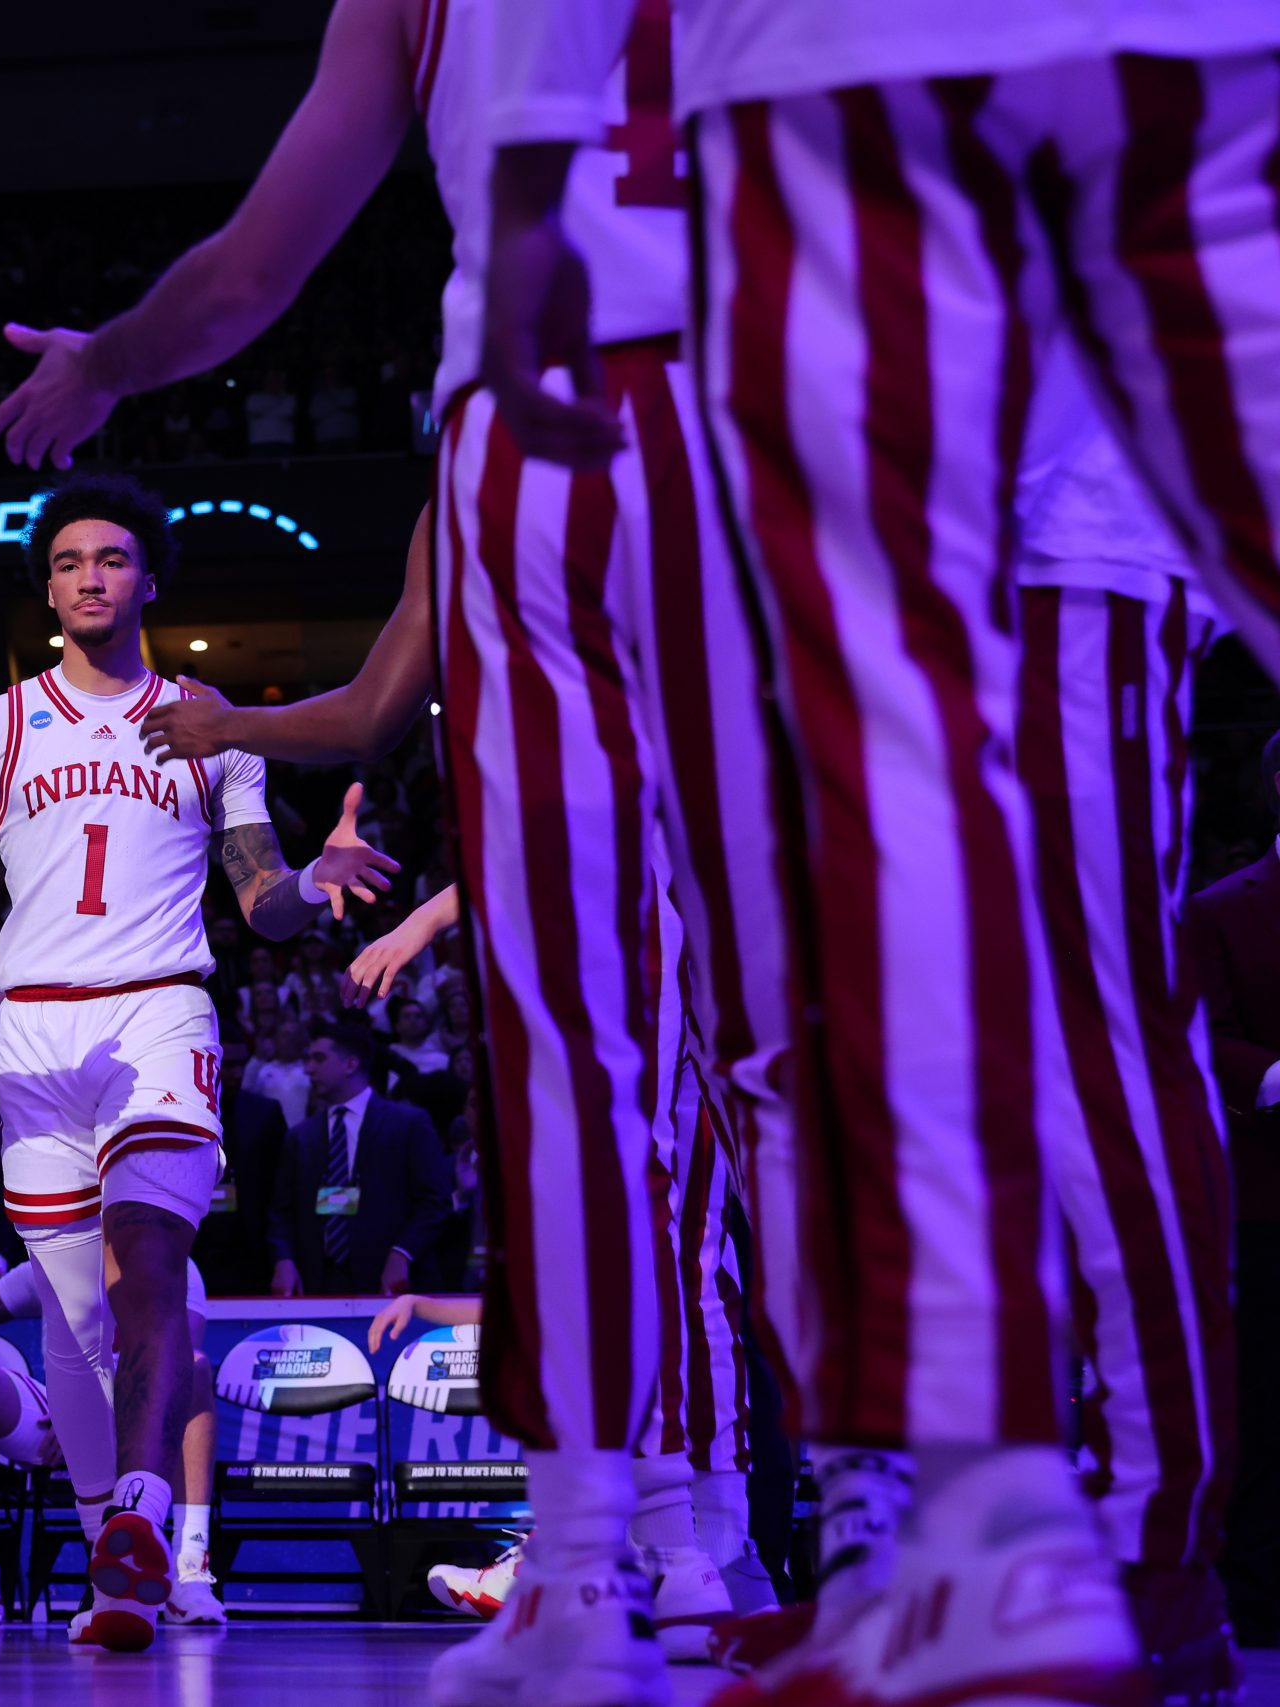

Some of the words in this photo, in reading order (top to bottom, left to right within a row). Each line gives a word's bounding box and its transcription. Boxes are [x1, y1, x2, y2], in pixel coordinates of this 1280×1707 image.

[32, 717, 51, 726] NCAA
[23, 761, 180, 821] INDIANA
[76, 823, 108, 916] 1
[270, 1351, 311, 1363] MARCH
[275, 1362, 330, 1375] MADNESS
[262, 1466, 277, 1477] THE
[278, 1466, 304, 1478] MEN'S
[305, 1467, 327, 1478] FINAL
[328, 1467, 351, 1478] FOUR
[411, 1466, 434, 1477] ROAD
[435, 1466, 446, 1477] TO
[447, 1466, 463, 1477] THE
[463, 1466, 489, 1477] MEN'S
[490, 1466, 513, 1477] FINAL
[514, 1466, 531, 1477] FOU
